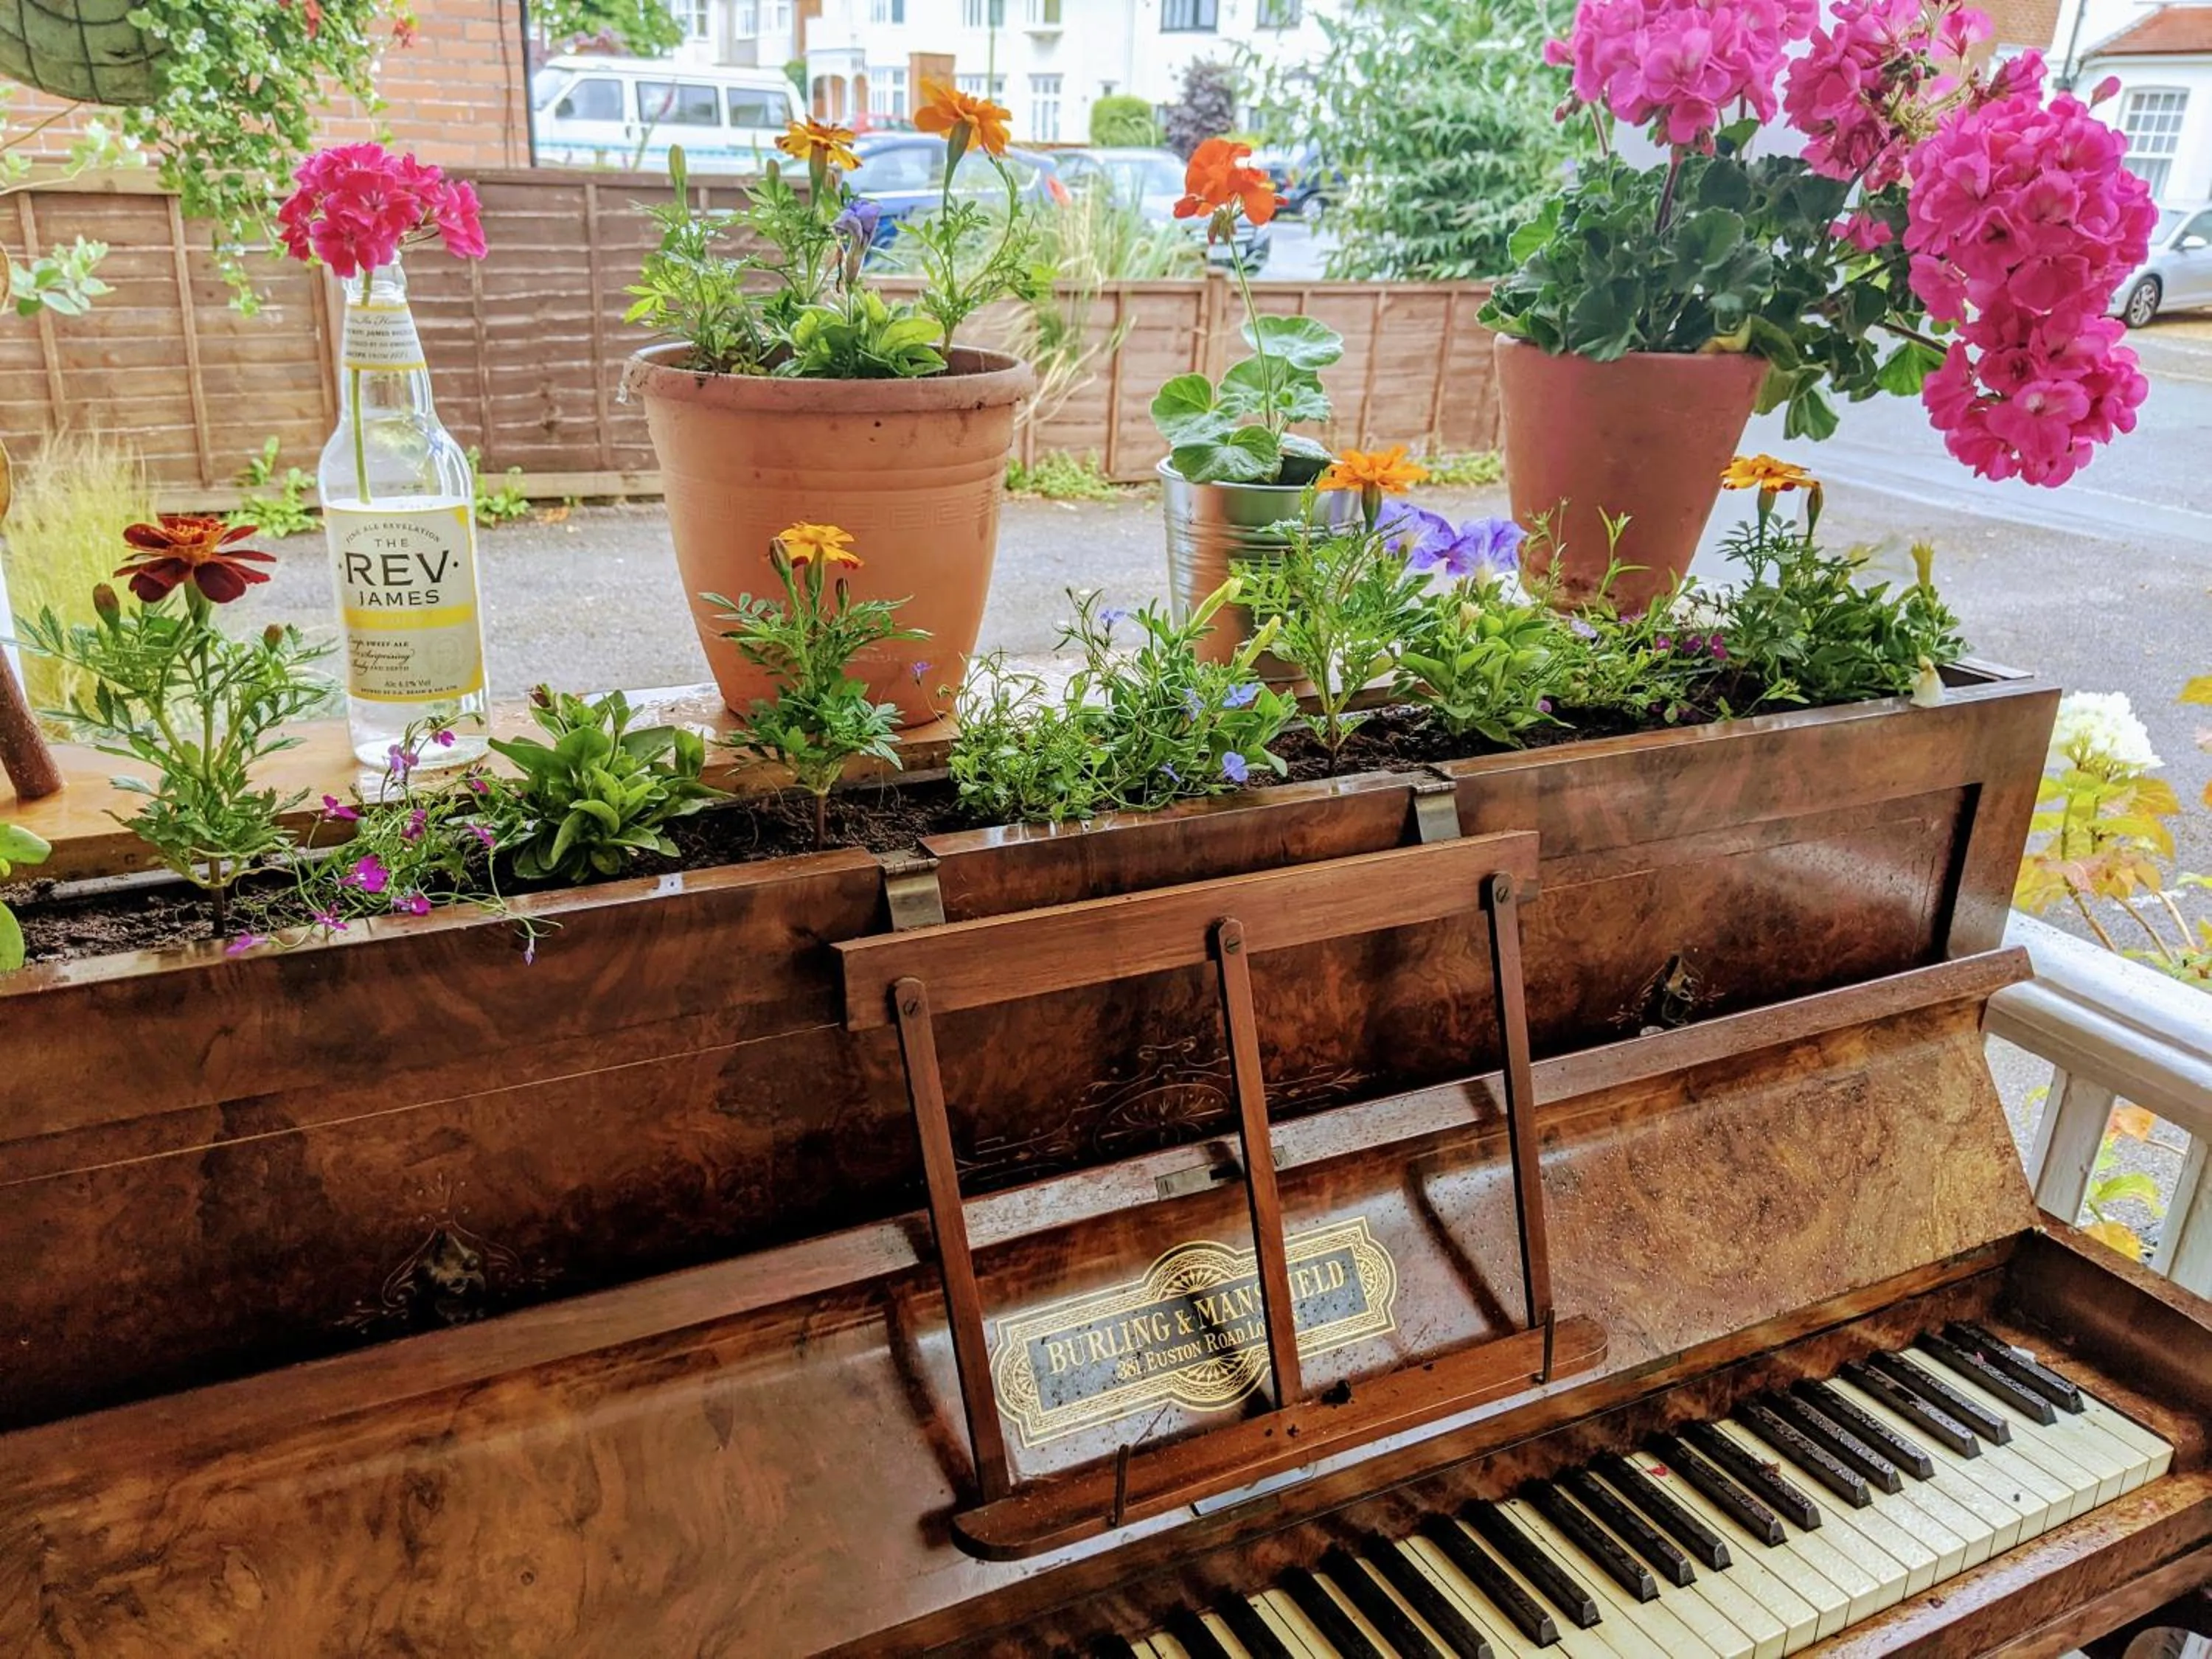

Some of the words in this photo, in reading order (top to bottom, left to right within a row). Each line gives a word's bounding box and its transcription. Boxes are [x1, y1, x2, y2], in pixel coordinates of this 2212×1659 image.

[374, 538, 409, 548] THE
[383, 523, 440, 543] REVELATION
[344, 550, 450, 586] REV
[359, 589, 440, 606] JAMES
[1044, 1311, 1172, 1374] BURLING
[1175, 1310, 1196, 1335] &
[1193, 1260, 1346, 1329] MANIELD
[1144, 1340, 1202, 1371] EUSTON
